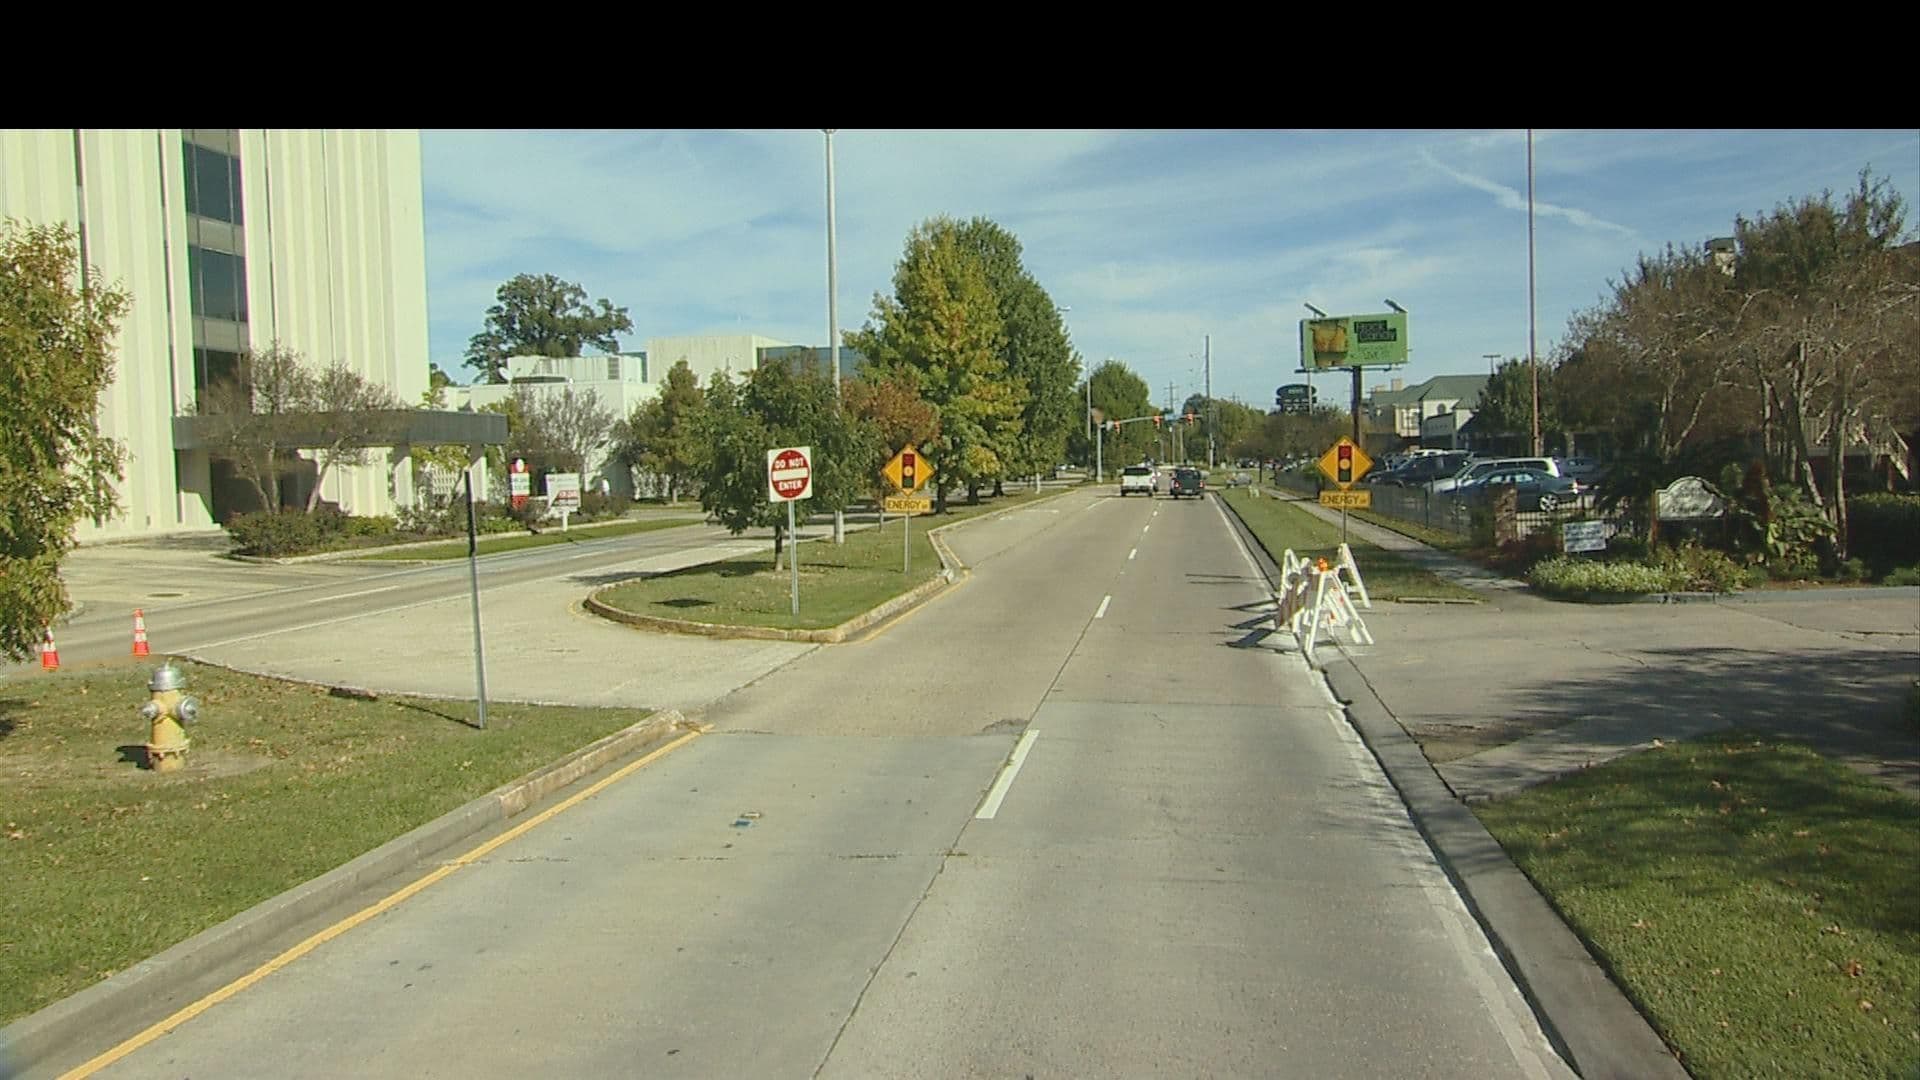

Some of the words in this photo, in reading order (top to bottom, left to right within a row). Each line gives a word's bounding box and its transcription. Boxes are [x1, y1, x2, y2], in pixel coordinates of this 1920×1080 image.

[775, 459, 786, 468] DO
[789, 457, 804, 468] NOT
[778, 480, 803, 491] ENTER
[887, 499, 921, 510] ENERGY
[1322, 494, 1360, 505] ENERGY
